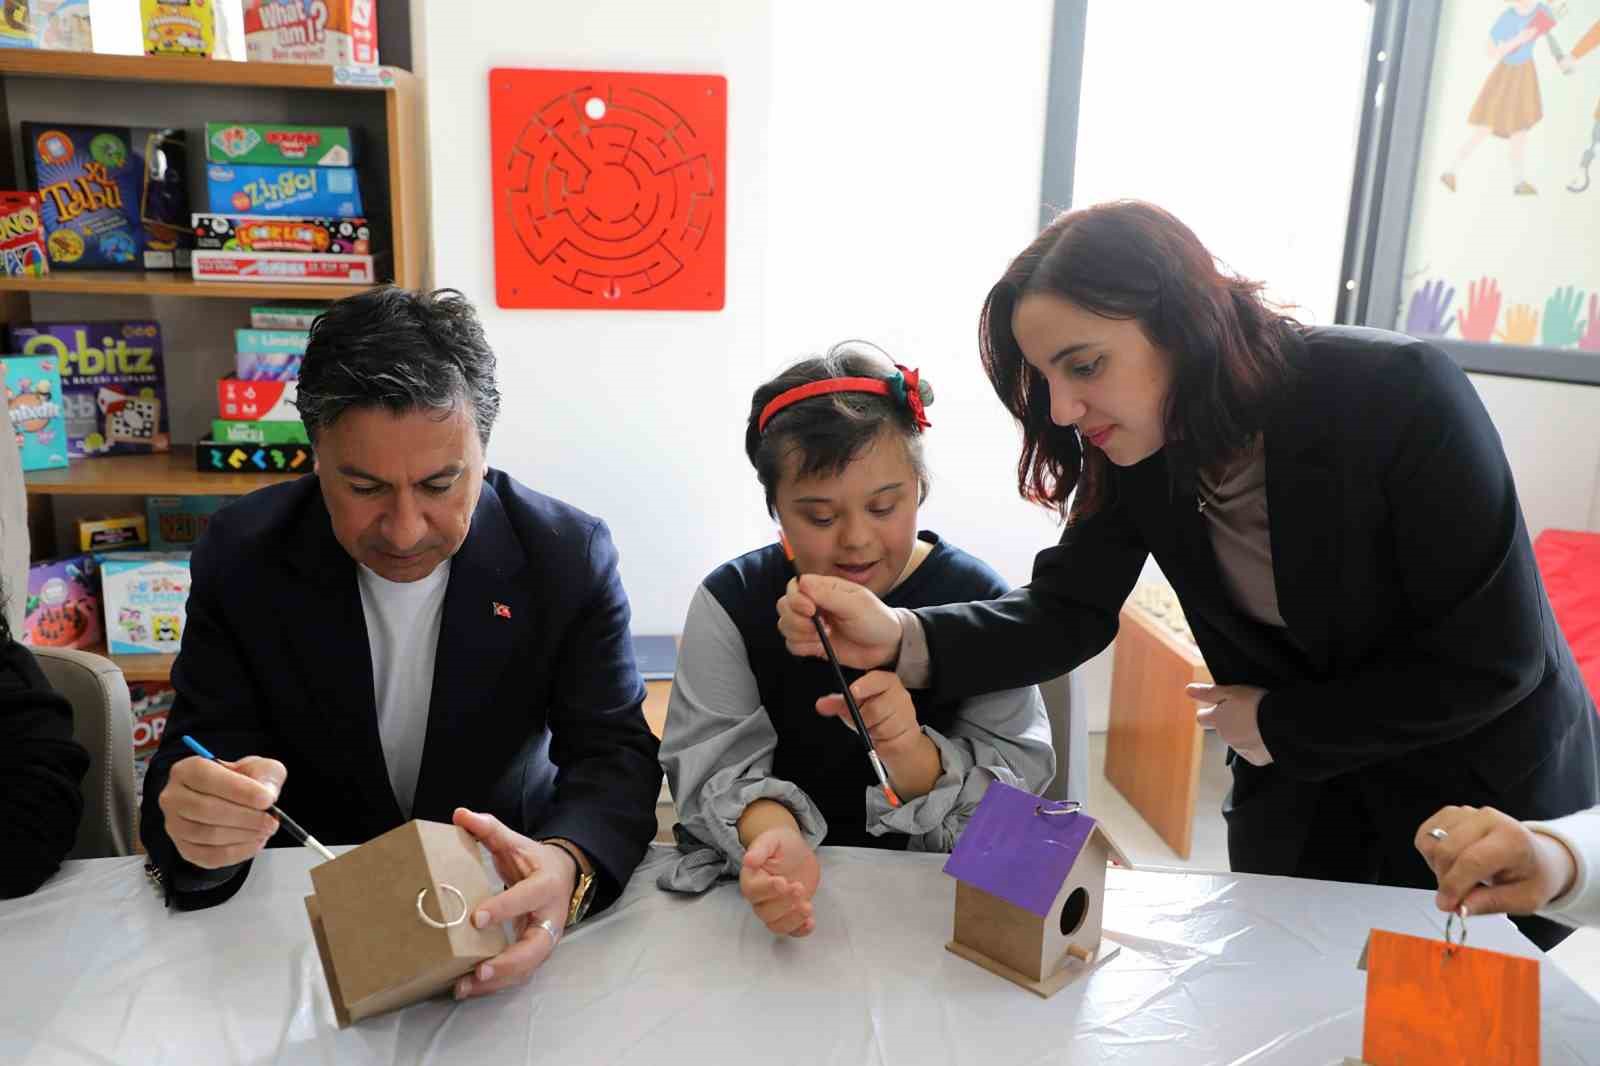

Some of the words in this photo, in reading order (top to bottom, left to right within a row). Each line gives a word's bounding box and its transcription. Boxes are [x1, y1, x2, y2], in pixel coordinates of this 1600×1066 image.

[259, 1, 306, 29] What
[279, 25, 306, 47] am
[40, 177, 123, 223] Tabu
[242, 168, 319, 206] Zingo!
[23, 329, 155, 376] Q-bitz
